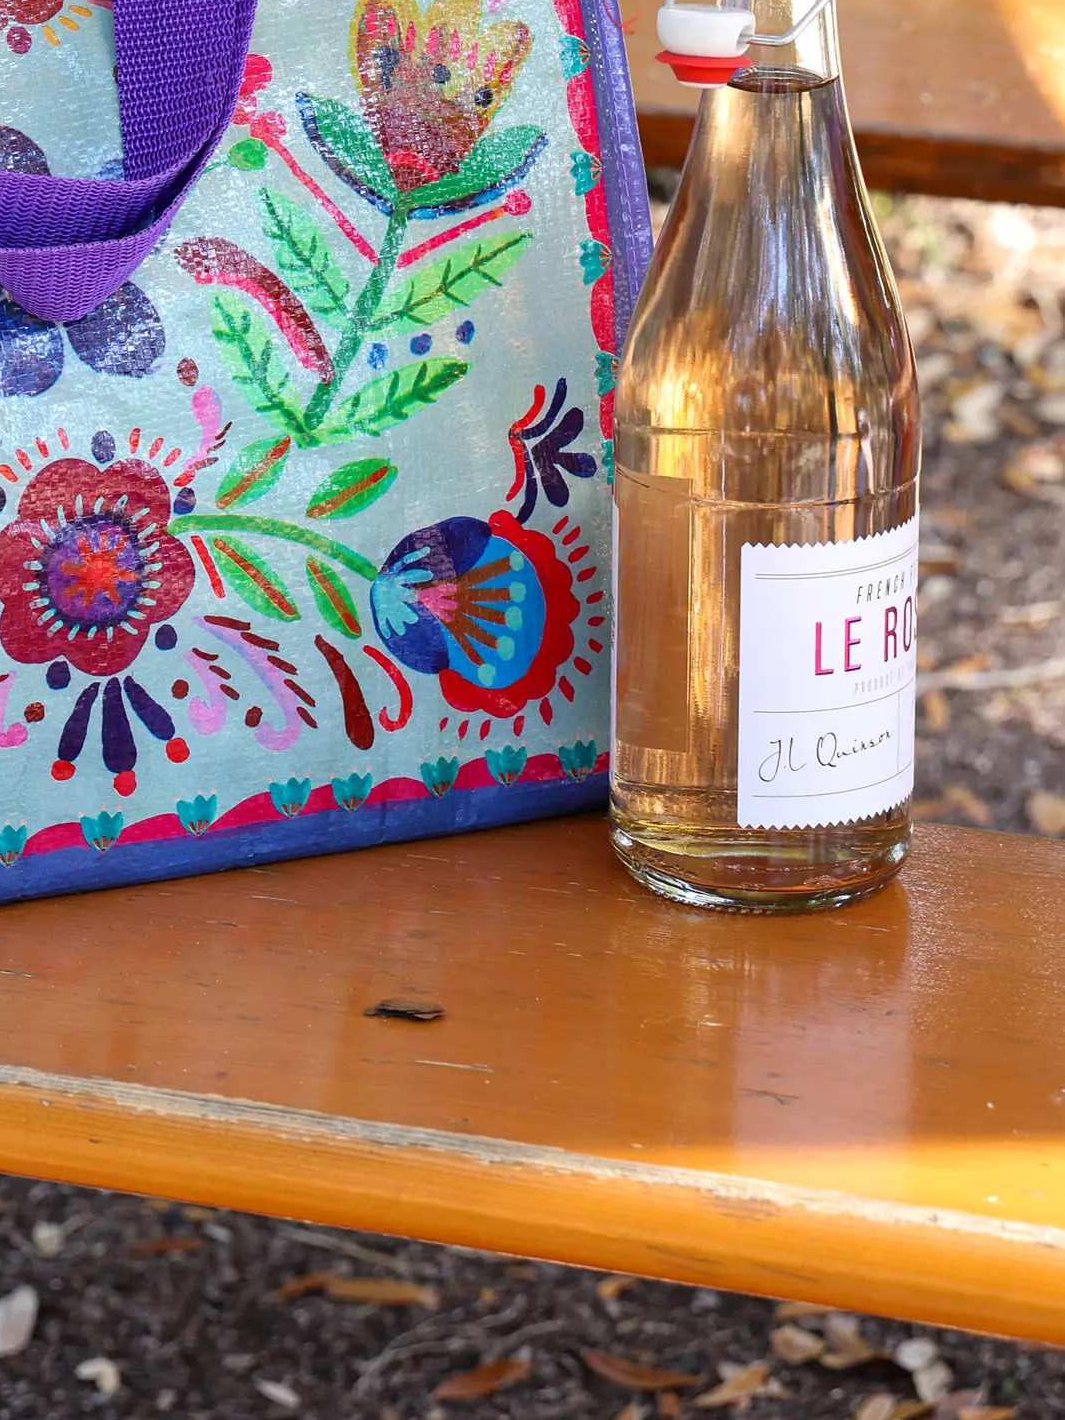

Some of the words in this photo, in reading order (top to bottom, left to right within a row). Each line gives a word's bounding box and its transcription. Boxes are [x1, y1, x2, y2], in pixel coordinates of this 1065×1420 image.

[856, 570, 905, 604] FRENCH
[814, 615, 862, 676] LE
[884, 595, 917, 662] RO
